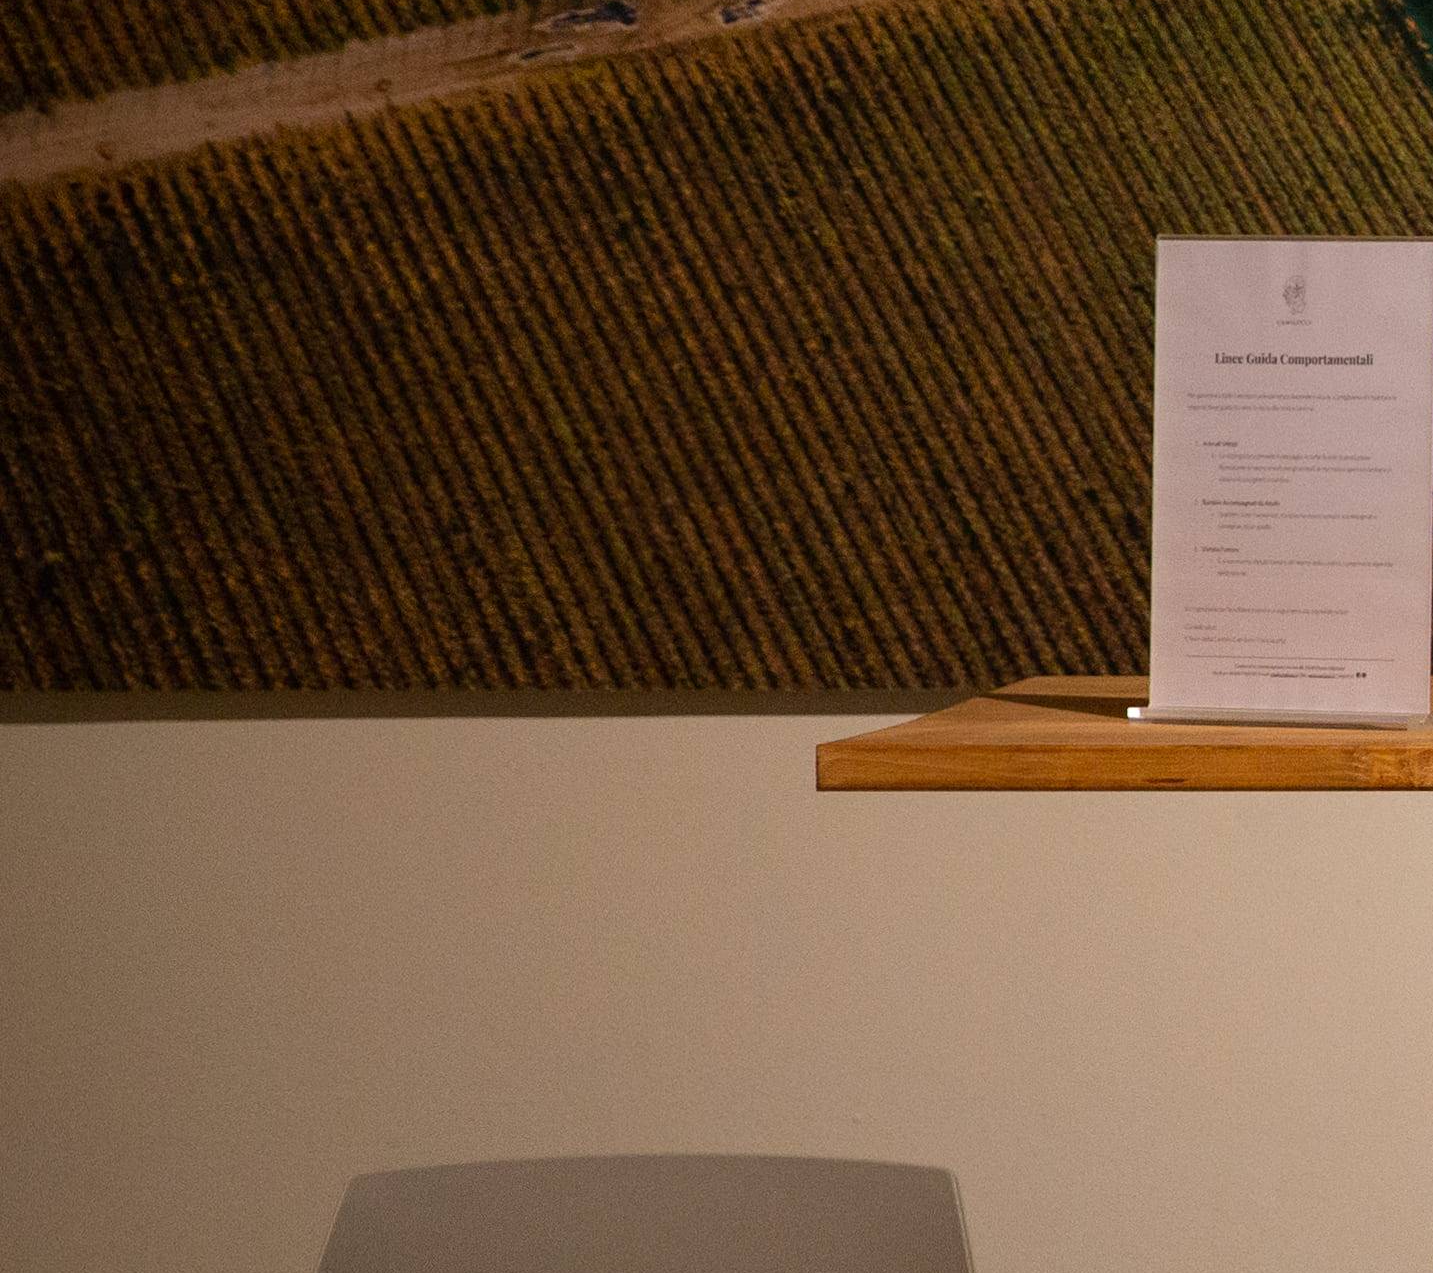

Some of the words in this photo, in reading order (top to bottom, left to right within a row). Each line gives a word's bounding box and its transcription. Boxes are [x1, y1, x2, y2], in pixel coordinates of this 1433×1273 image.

[1214, 351, 1245, 366] Linee
[1246, 351, 1278, 366] Guida
[1280, 352, 1374, 368] Comportamentali
